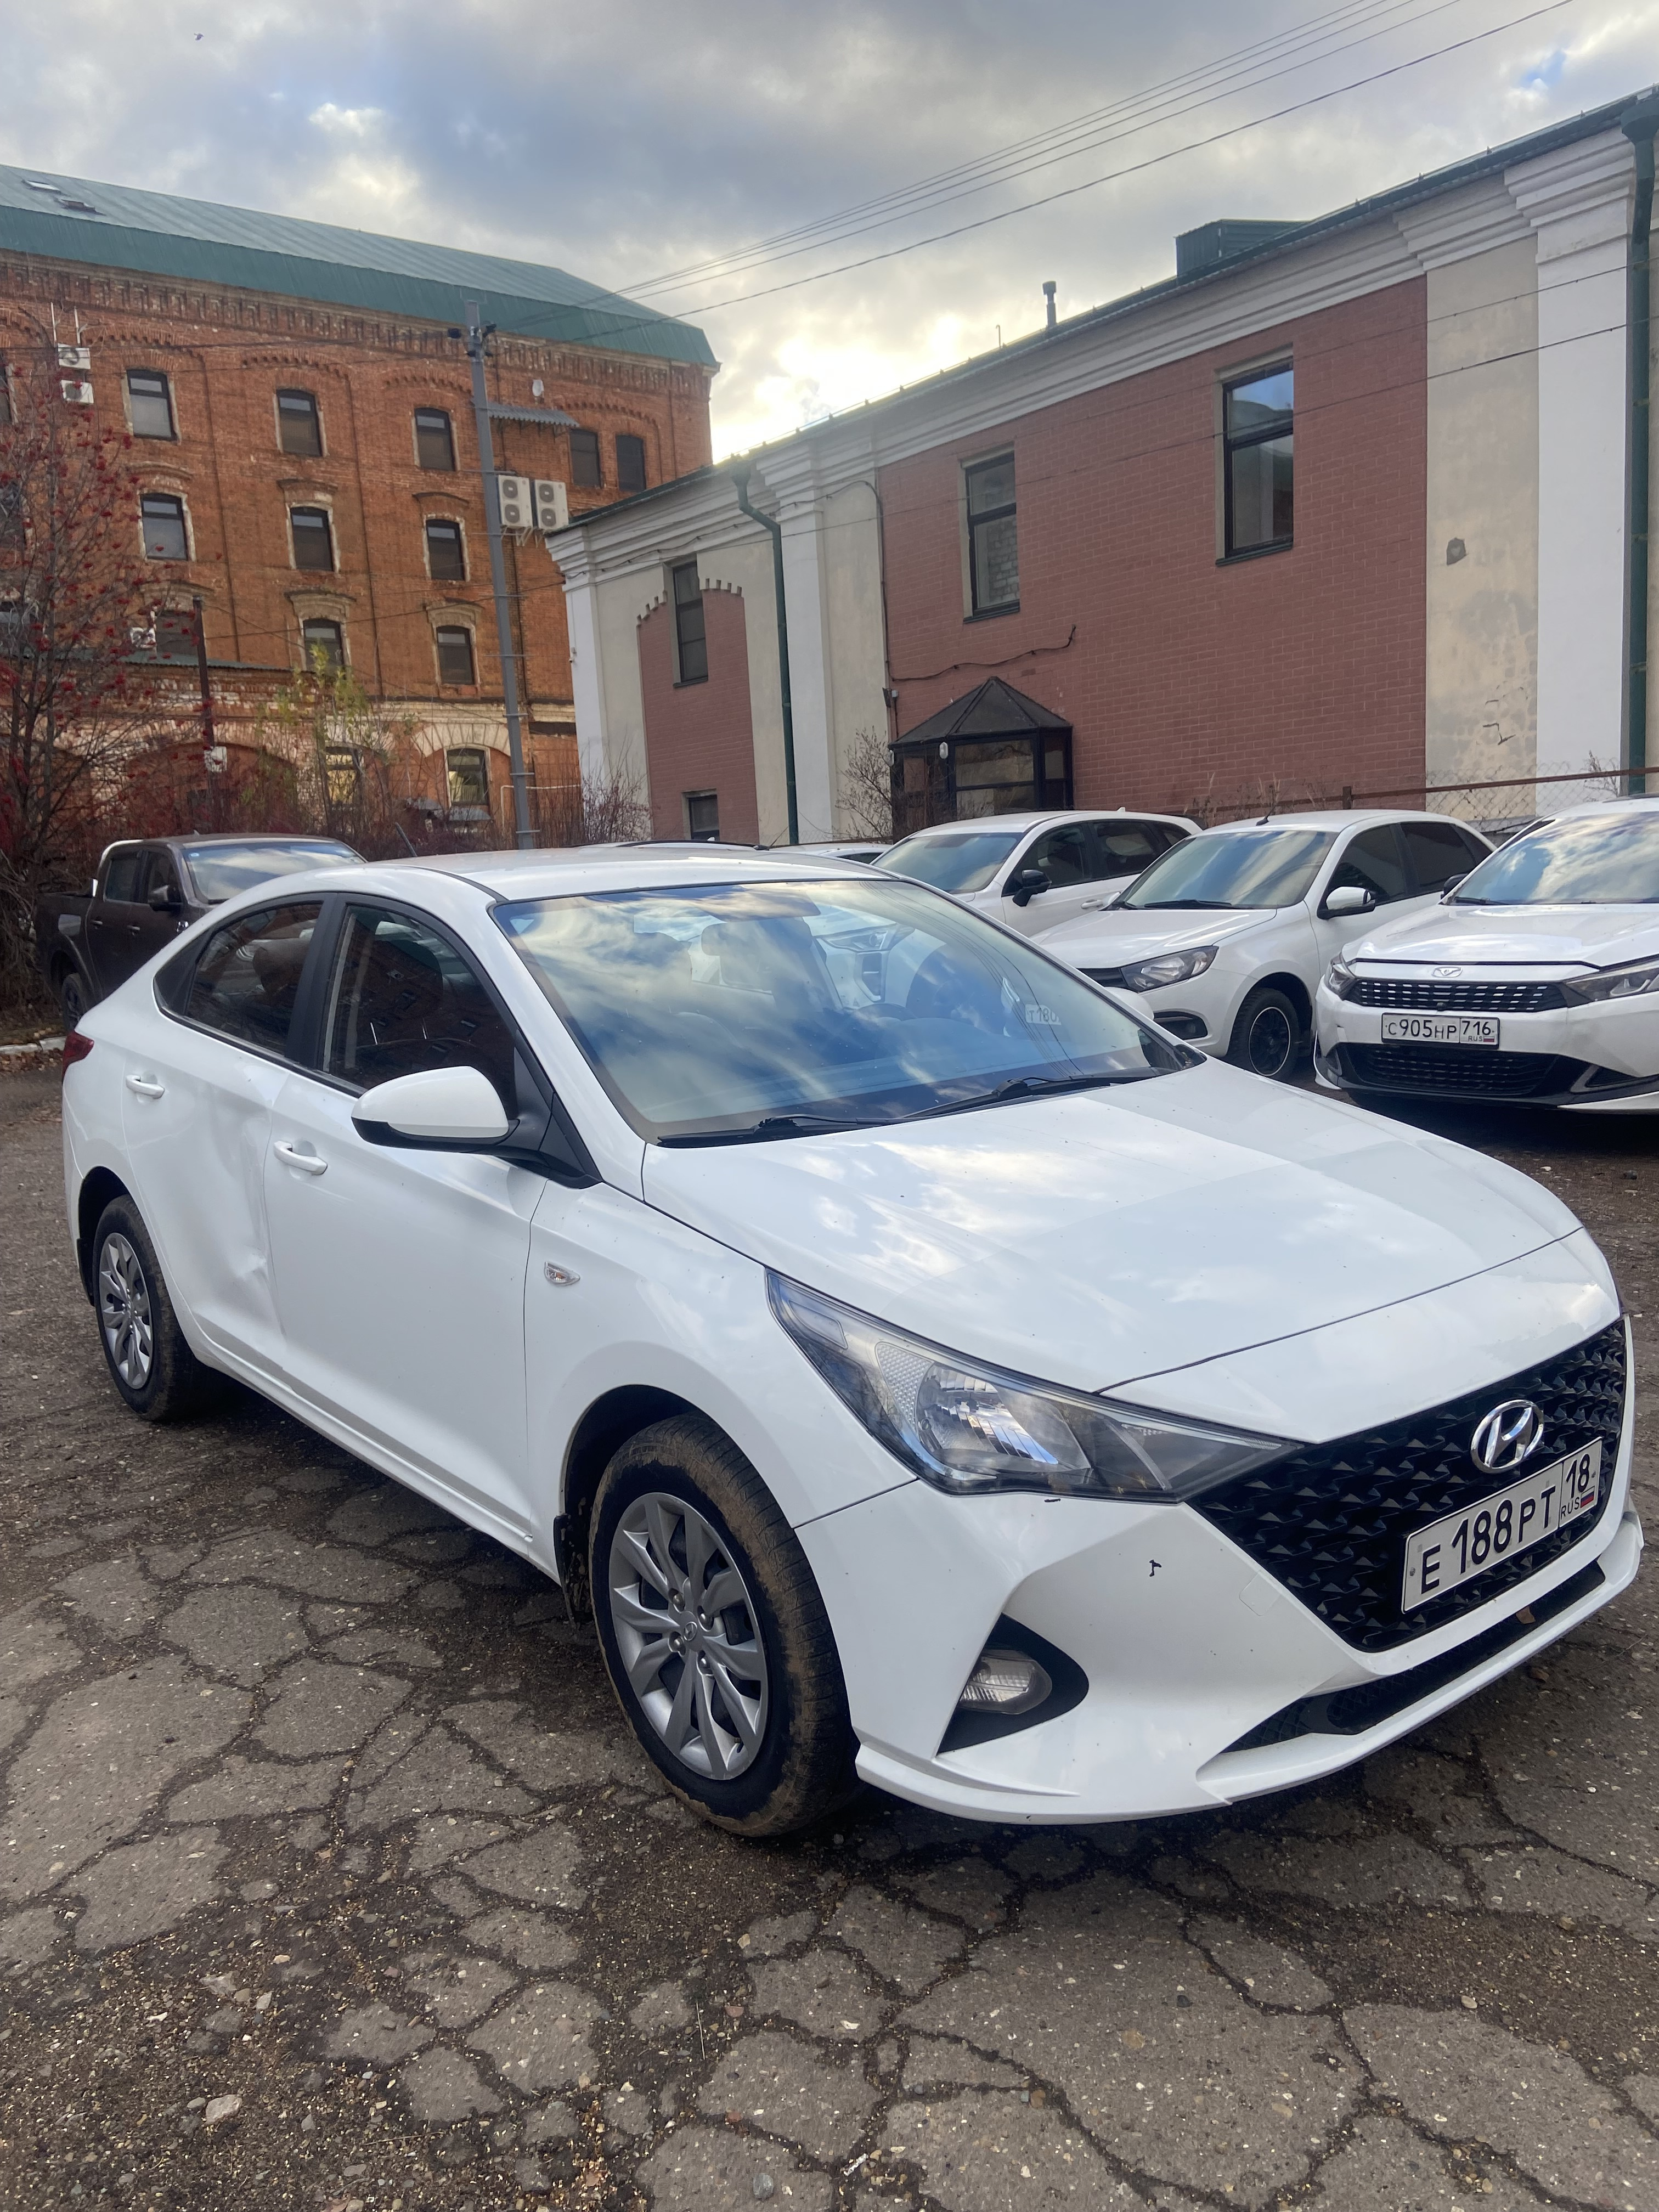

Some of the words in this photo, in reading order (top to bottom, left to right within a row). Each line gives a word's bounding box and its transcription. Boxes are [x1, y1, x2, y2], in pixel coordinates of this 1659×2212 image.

[1388, 1019, 1457, 1040] С905НР
[1462, 1020, 1491, 1035] 716
[1560, 1496, 1580, 1520] RUS
[1421, 1486, 1556, 1594] Е188РТ
[1566, 1453, 1590, 1498] 18
